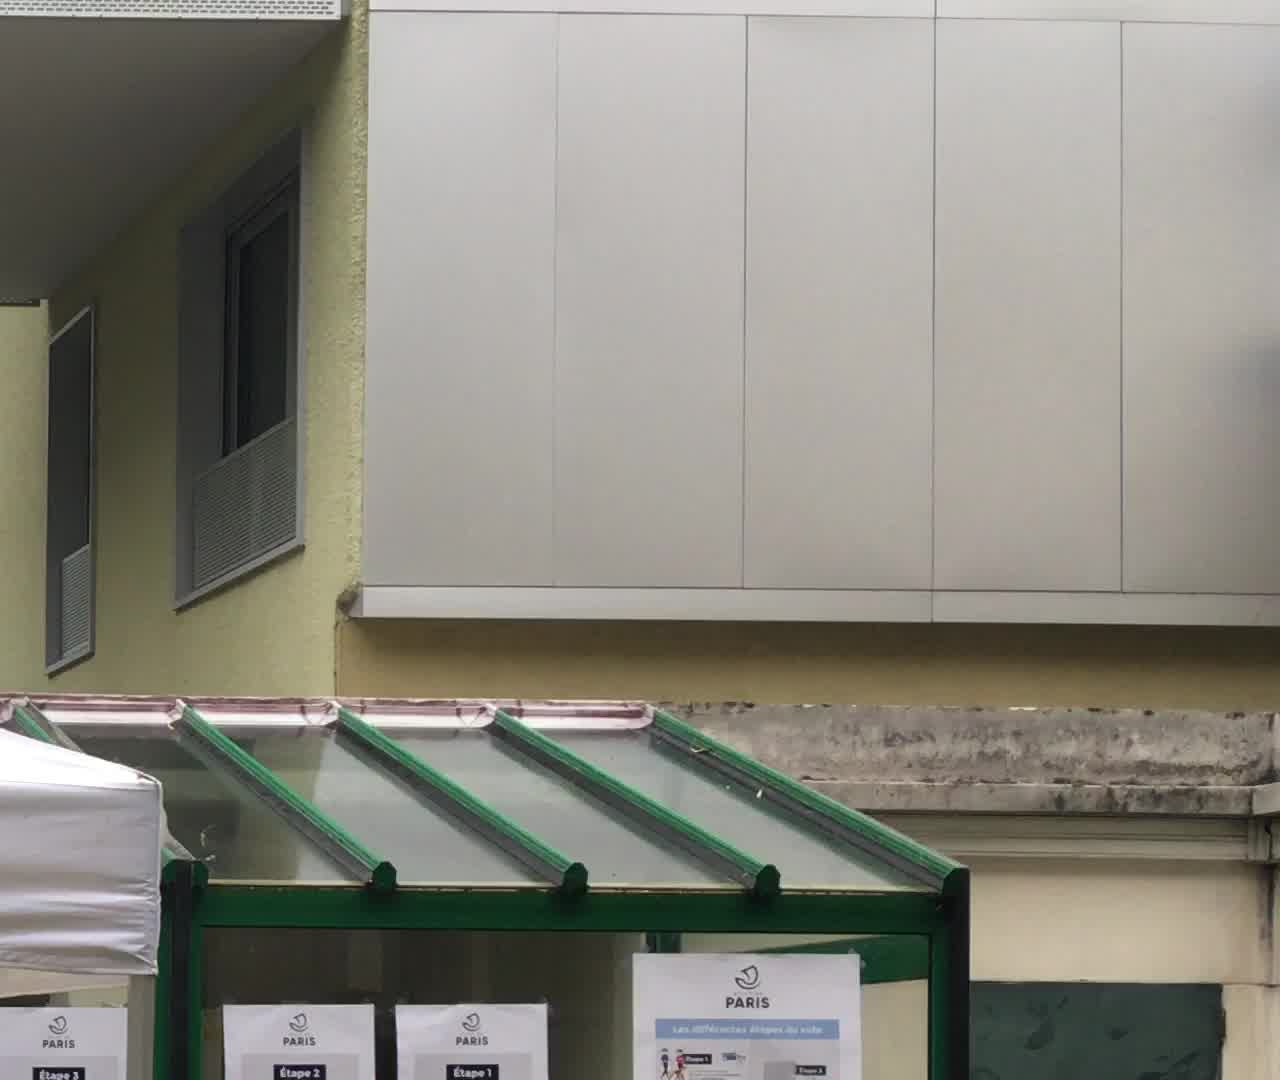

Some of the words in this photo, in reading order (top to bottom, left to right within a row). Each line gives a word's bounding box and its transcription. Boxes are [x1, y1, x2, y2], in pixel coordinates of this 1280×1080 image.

[725, 996, 771, 1009] PARIS
[42, 1039, 76, 1049] PARIS
[283, 1037, 316, 1046] PARIS
[455, 1036, 489, 1046] PARIS
[72, 1071, 79, 1080] 3
[279, 1066, 311, 1079] Étape
[313, 1069, 321, 1078] 2
[453, 1066, 485, 1079] Étape
[487, 1068, 492, 1078] 1
